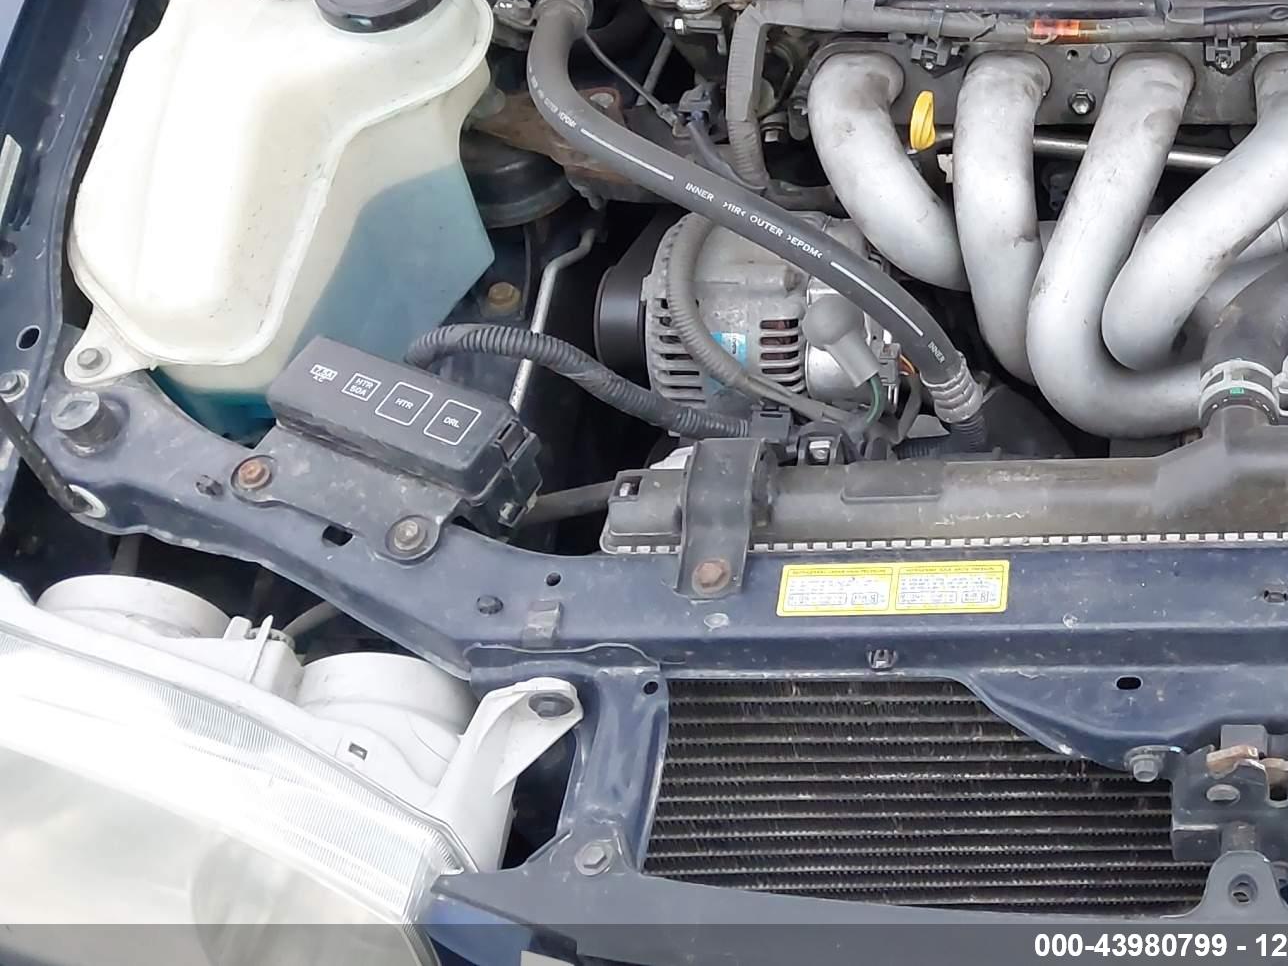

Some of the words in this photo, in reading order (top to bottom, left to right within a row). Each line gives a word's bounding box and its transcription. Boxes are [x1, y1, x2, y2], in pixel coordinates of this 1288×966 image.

[685, 182, 715, 202] INNER
[749, 215, 784, 237] OUTER
[355, 377, 374, 390] HTR
[349, 385, 367, 397] 50A
[394, 397, 415, 410] HTR
[443, 416, 460, 429] DRL
